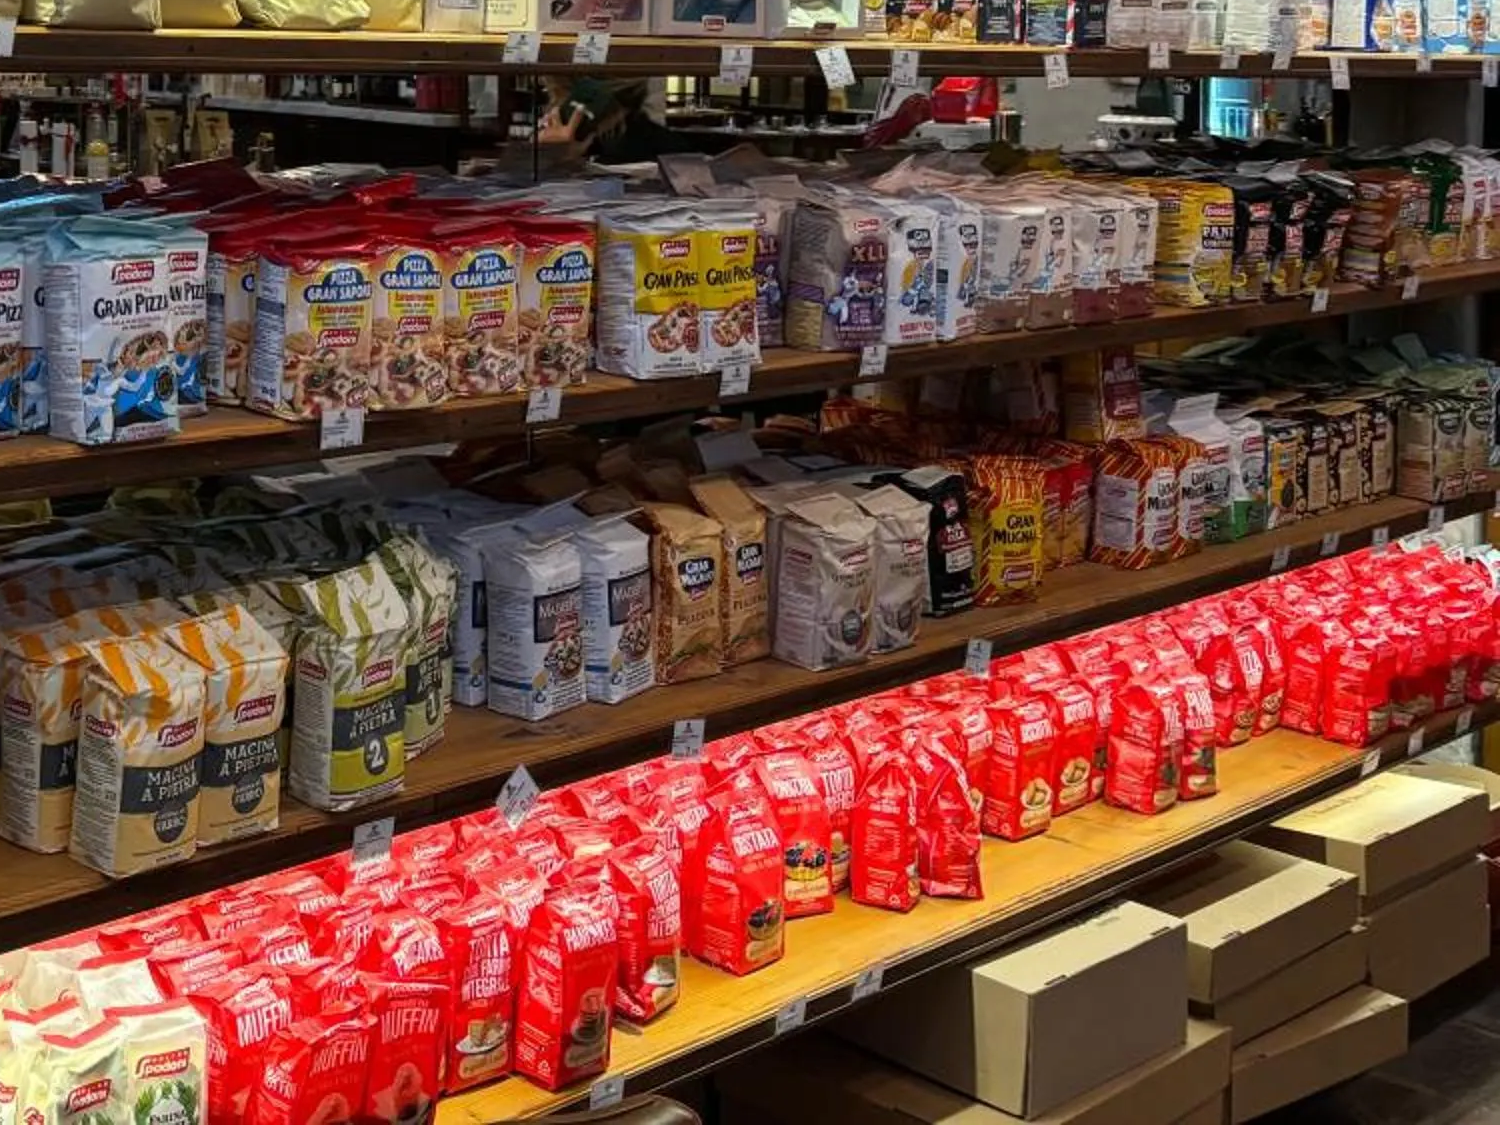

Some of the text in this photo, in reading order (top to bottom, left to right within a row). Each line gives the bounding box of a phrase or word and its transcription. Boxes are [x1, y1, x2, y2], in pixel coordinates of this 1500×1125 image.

[93, 297, 132, 320] GRAN
[369, 738, 385, 769] 2
[141, 787, 154, 802] A
[235, 998, 293, 1048] MUFFIN
[379, 1007, 440, 1044] MUFFIN
[138, 1057, 187, 1078] Spadoni
[310, 1035, 370, 1076] MUFFIN
